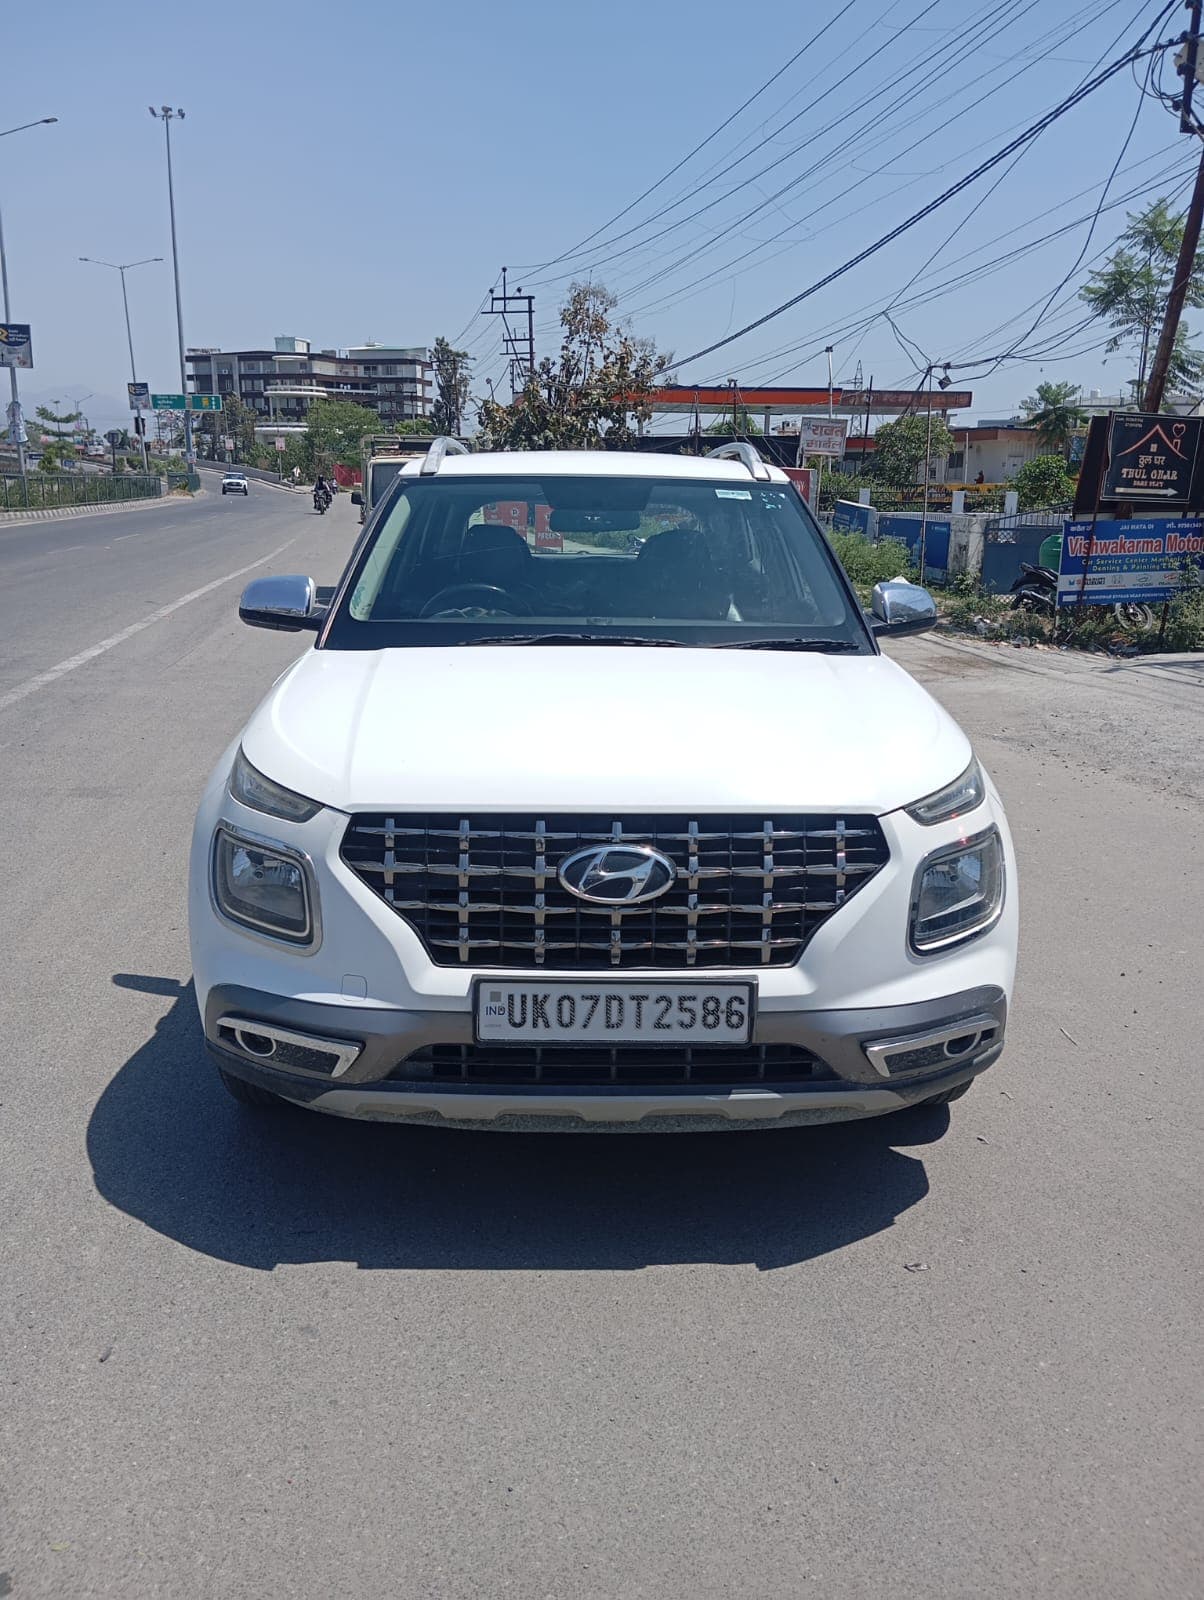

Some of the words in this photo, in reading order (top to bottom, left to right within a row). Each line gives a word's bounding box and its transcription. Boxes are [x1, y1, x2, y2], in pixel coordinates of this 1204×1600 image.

[1068, 535, 1163, 557] Vishwakarma
[485, 1005, 506, 1016] IND
[507, 993, 747, 1030] UK07DT2586
